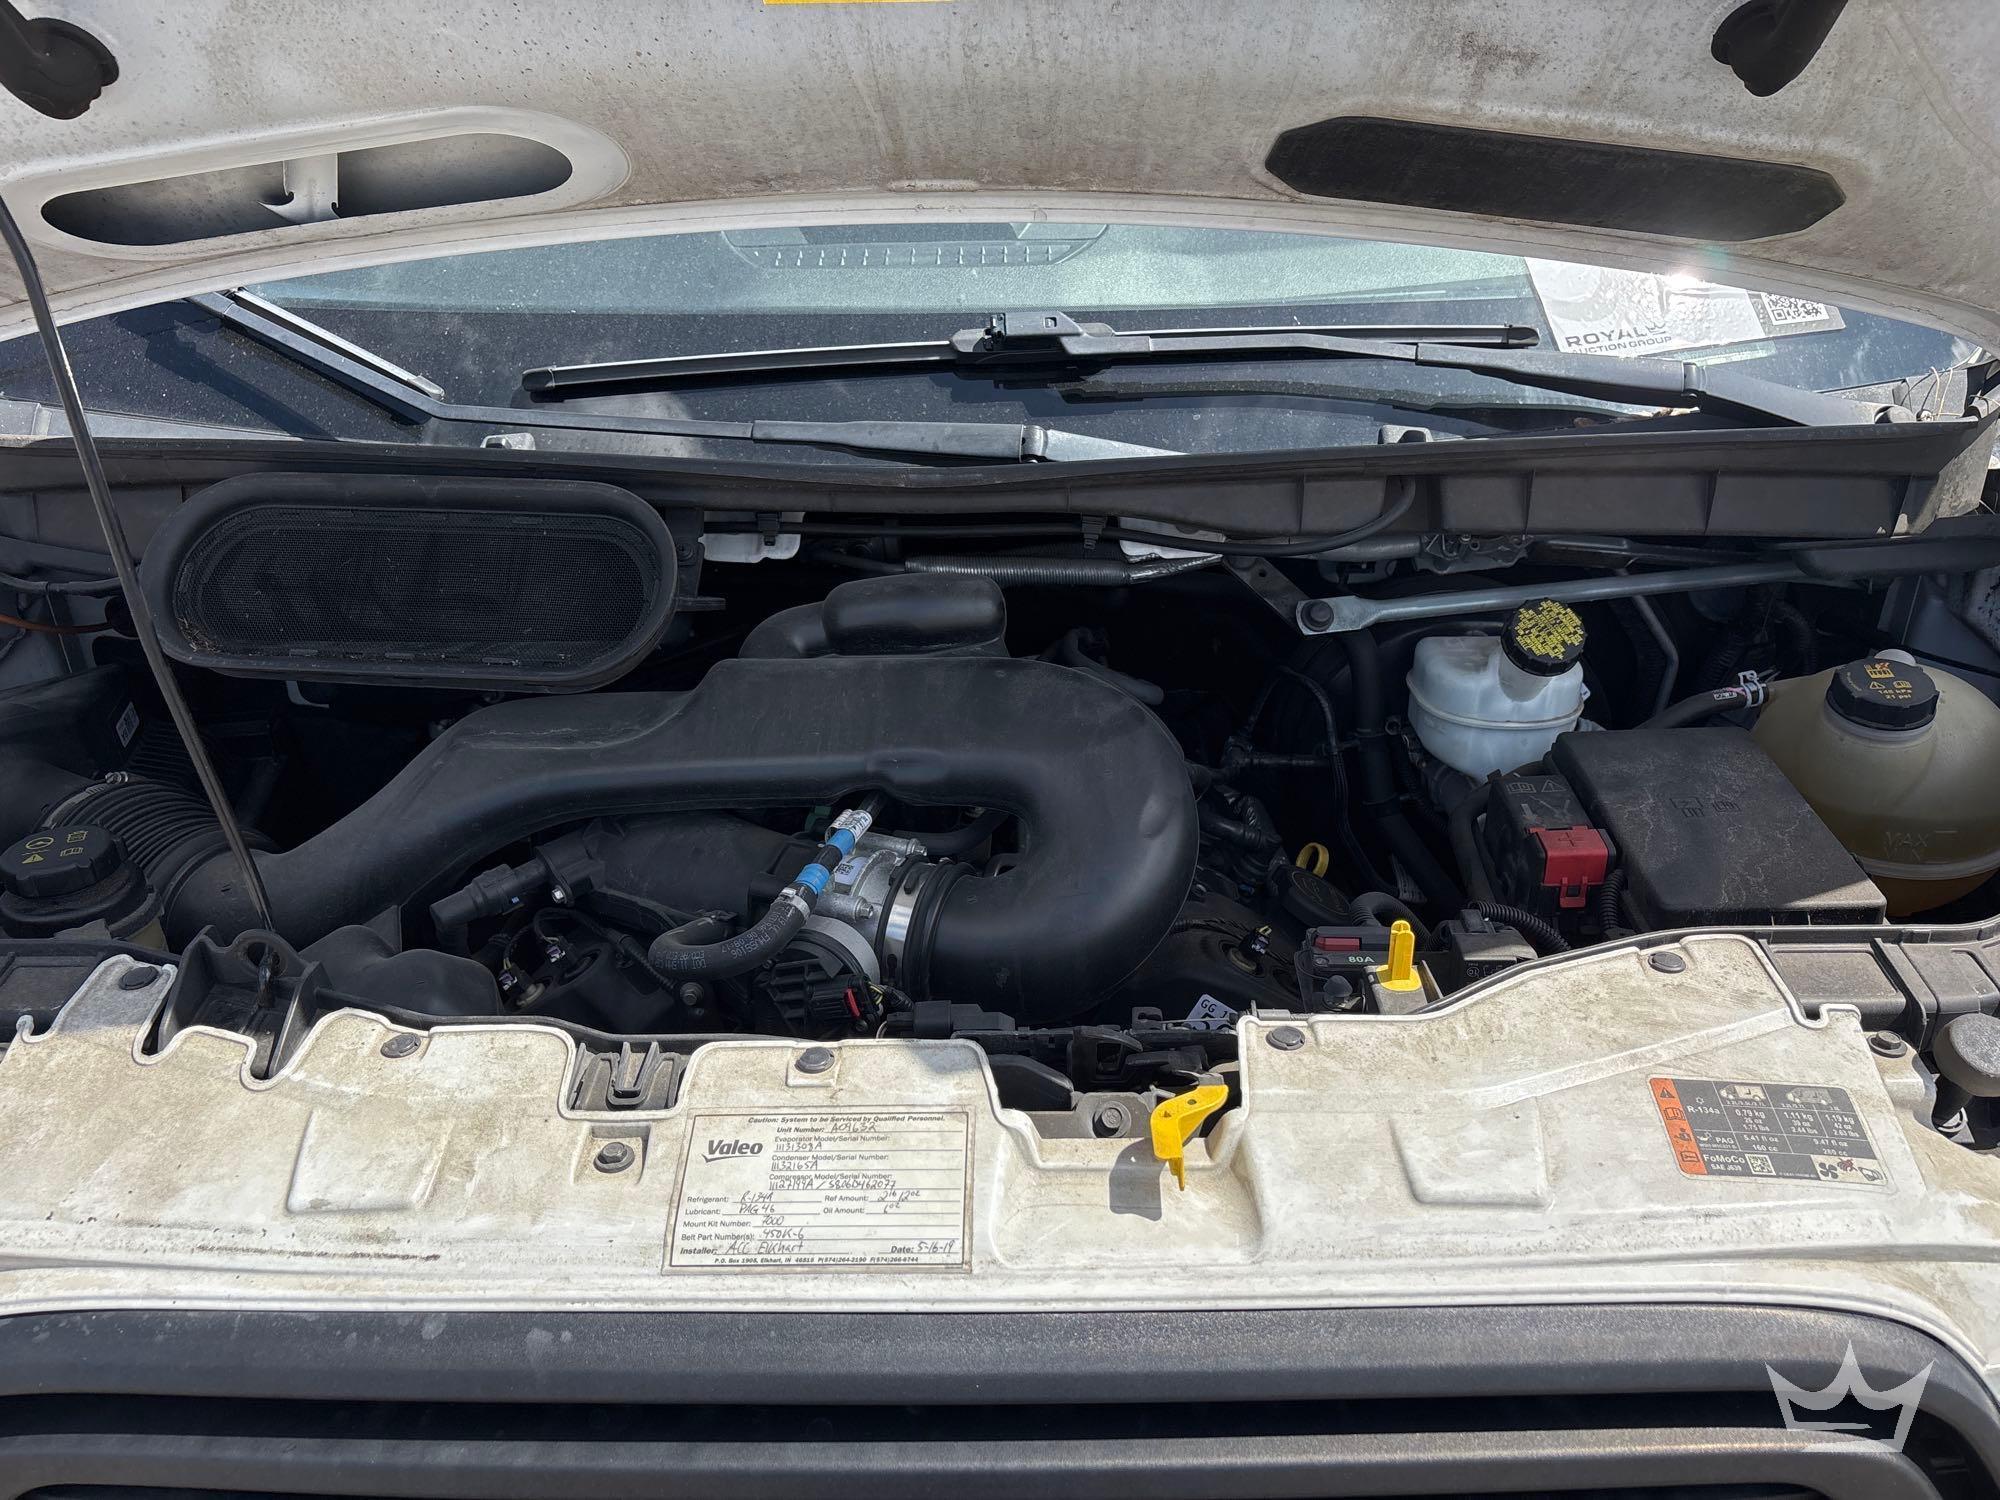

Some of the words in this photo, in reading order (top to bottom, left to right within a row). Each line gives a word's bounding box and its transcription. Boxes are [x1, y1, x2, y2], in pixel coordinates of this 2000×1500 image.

[1565, 327, 1647, 347] ROYAL
[1629, 336, 1672, 347] GROUP
[1200, 999, 1217, 1013] GG
[1686, 1105, 1720, 1114] R-134a
[1735, 1109, 1753, 1117] 0.79
[1753, 1110, 1766, 1119] kg
[780, 1116, 808, 1124] System
[830, 1115, 862, 1123] Serviced
[862, 1115, 872, 1124] by
[873, 1115, 905, 1124] Qualified
[1783, 1111, 1801, 1119] 1.11
[1801, 1113, 1814, 1122] kg
[1825, 1114, 1842, 1122] 1.19
[1842, 1115, 1855, 1125] kg
[813, 1135, 859, 1143] Model/Serial
[708, 1139, 763, 1155] Valeo
[811, 1153, 857, 1161] Model/Serial
[858, 1153, 889, 1161] Number:
[1702, 1154, 1746, 1164] FoMoCo
[769, 1173, 812, 1181] Compressor
[685, 1208, 721, 1216] Lubricant:
[719, 1220, 751, 1228] Number:
[681, 1233, 697, 1241] Belt
[714, 1233, 755, 1241] Number(s):
[680, 1247, 719, 1255] Installer:
[891, 1245, 915, 1254] Date:
